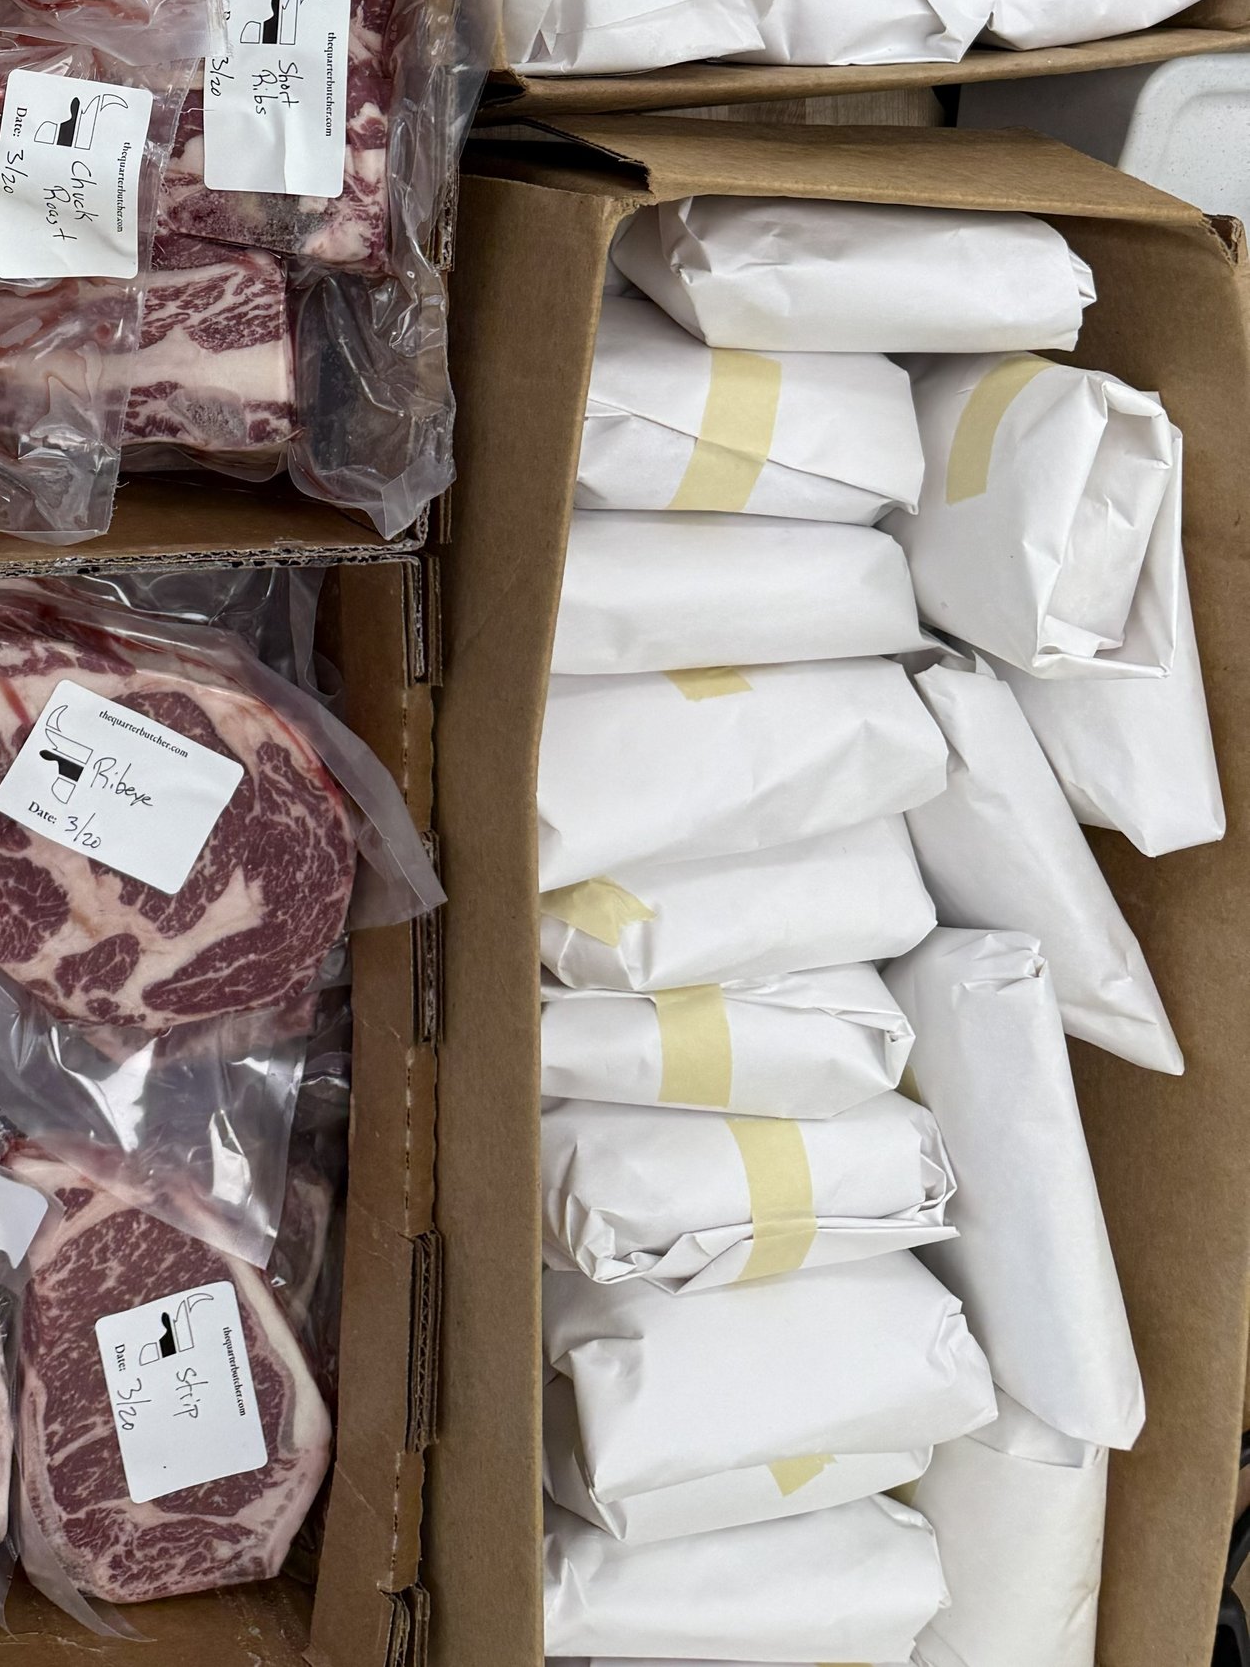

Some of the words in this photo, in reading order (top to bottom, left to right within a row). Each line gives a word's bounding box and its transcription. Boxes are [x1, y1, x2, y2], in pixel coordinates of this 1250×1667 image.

[210, 57, 235, 97] 3/20
[251, 69, 279, 115] Ribs
[278, 59, 304, 108] Short
[324, 32, 337, 137] thequarterbutcher.com
[13, 107, 27, 137] Date:
[1, 149, 28, 194] 3/20
[71, 161, 99, 222] Chuck
[117, 142, 131, 232] thequarterbutcher.com
[43, 185, 77, 241] Roast
[99, 710, 188, 758] thequarterbutcher.com
[90, 757, 153, 807] Ribeye
[28, 801, 57, 824] Date:
[65, 812, 101, 849] 3/20
[115, 1344, 126, 1372] Date:
[223, 1326, 246, 1416] thequarterbutcher.com
[116, 1378, 152, 1430] 3/20
